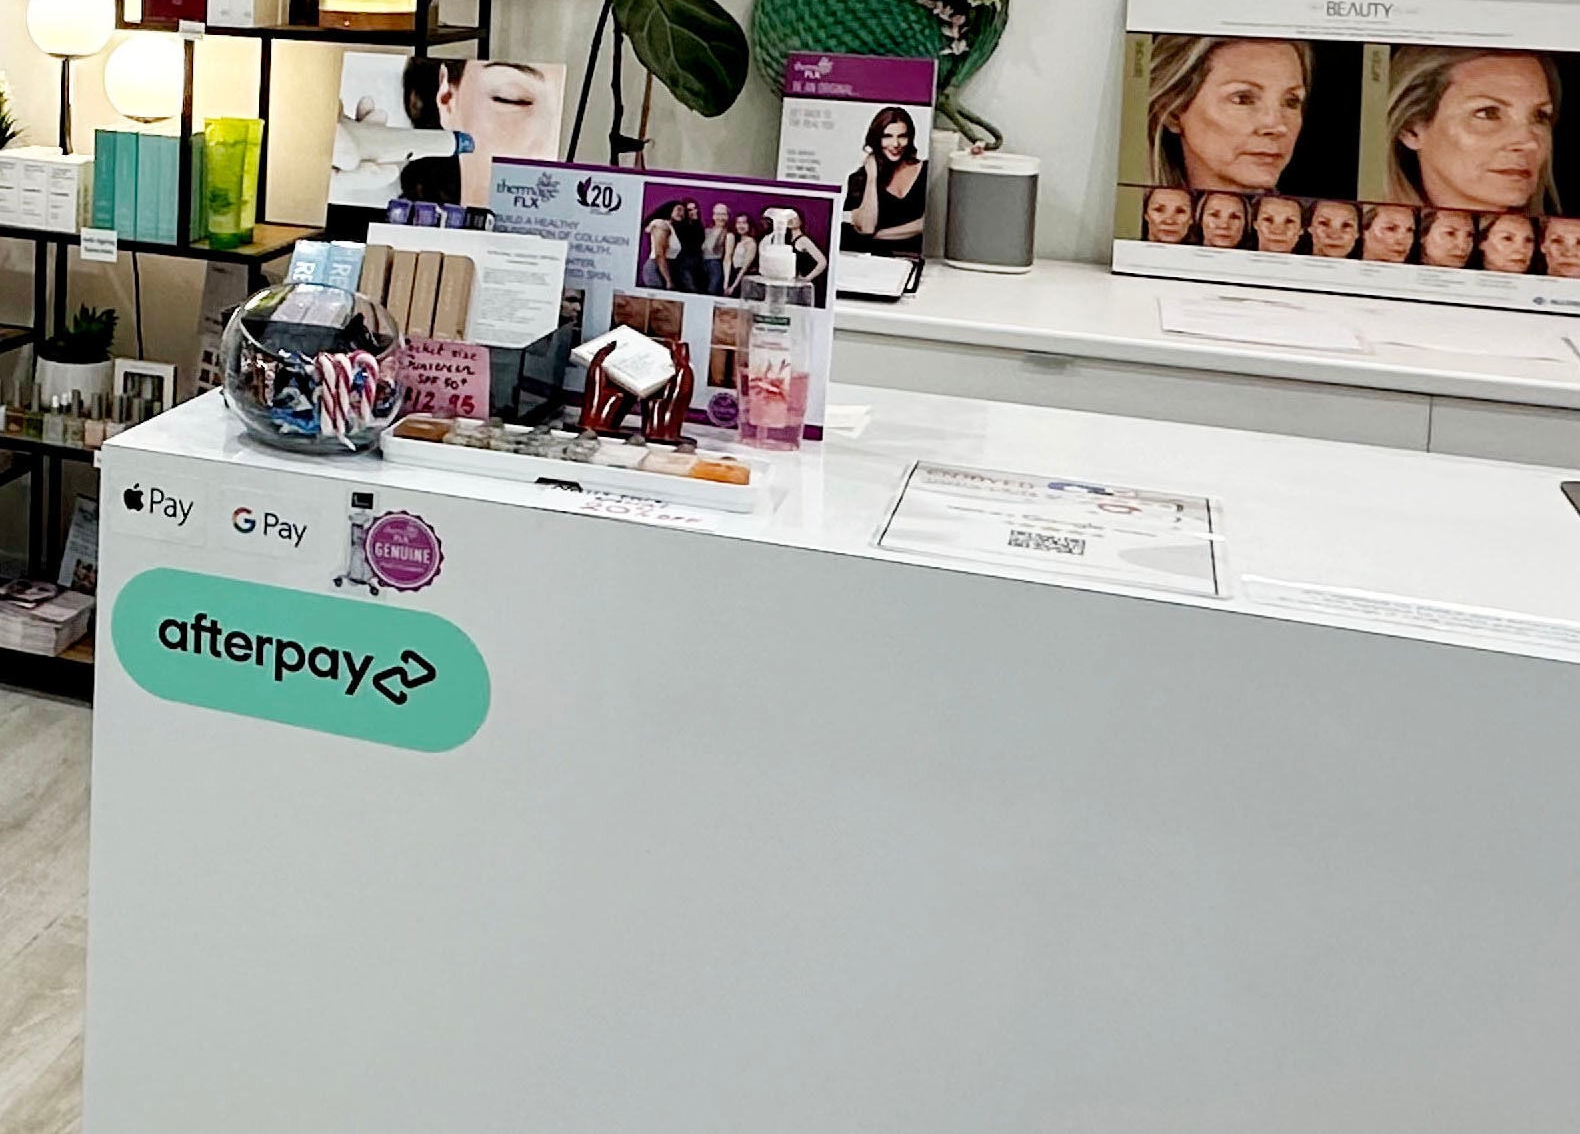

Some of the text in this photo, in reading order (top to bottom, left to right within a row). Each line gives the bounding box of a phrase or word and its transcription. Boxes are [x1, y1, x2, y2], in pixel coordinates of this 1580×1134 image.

[1326, 0, 1394, 18] BEAUTY
[514, 197, 539, 209] FLX
[591, 185, 614, 208] 20
[535, 217, 580, 230] HEALTHY
[575, 233, 630, 246] COLLAGEN
[418, 373, 439, 385] SPF
[150, 488, 193, 526] Pay
[264, 513, 307, 547] Pay
[375, 542, 430, 564] GENUINE
[159, 613, 374, 695] afterpay
